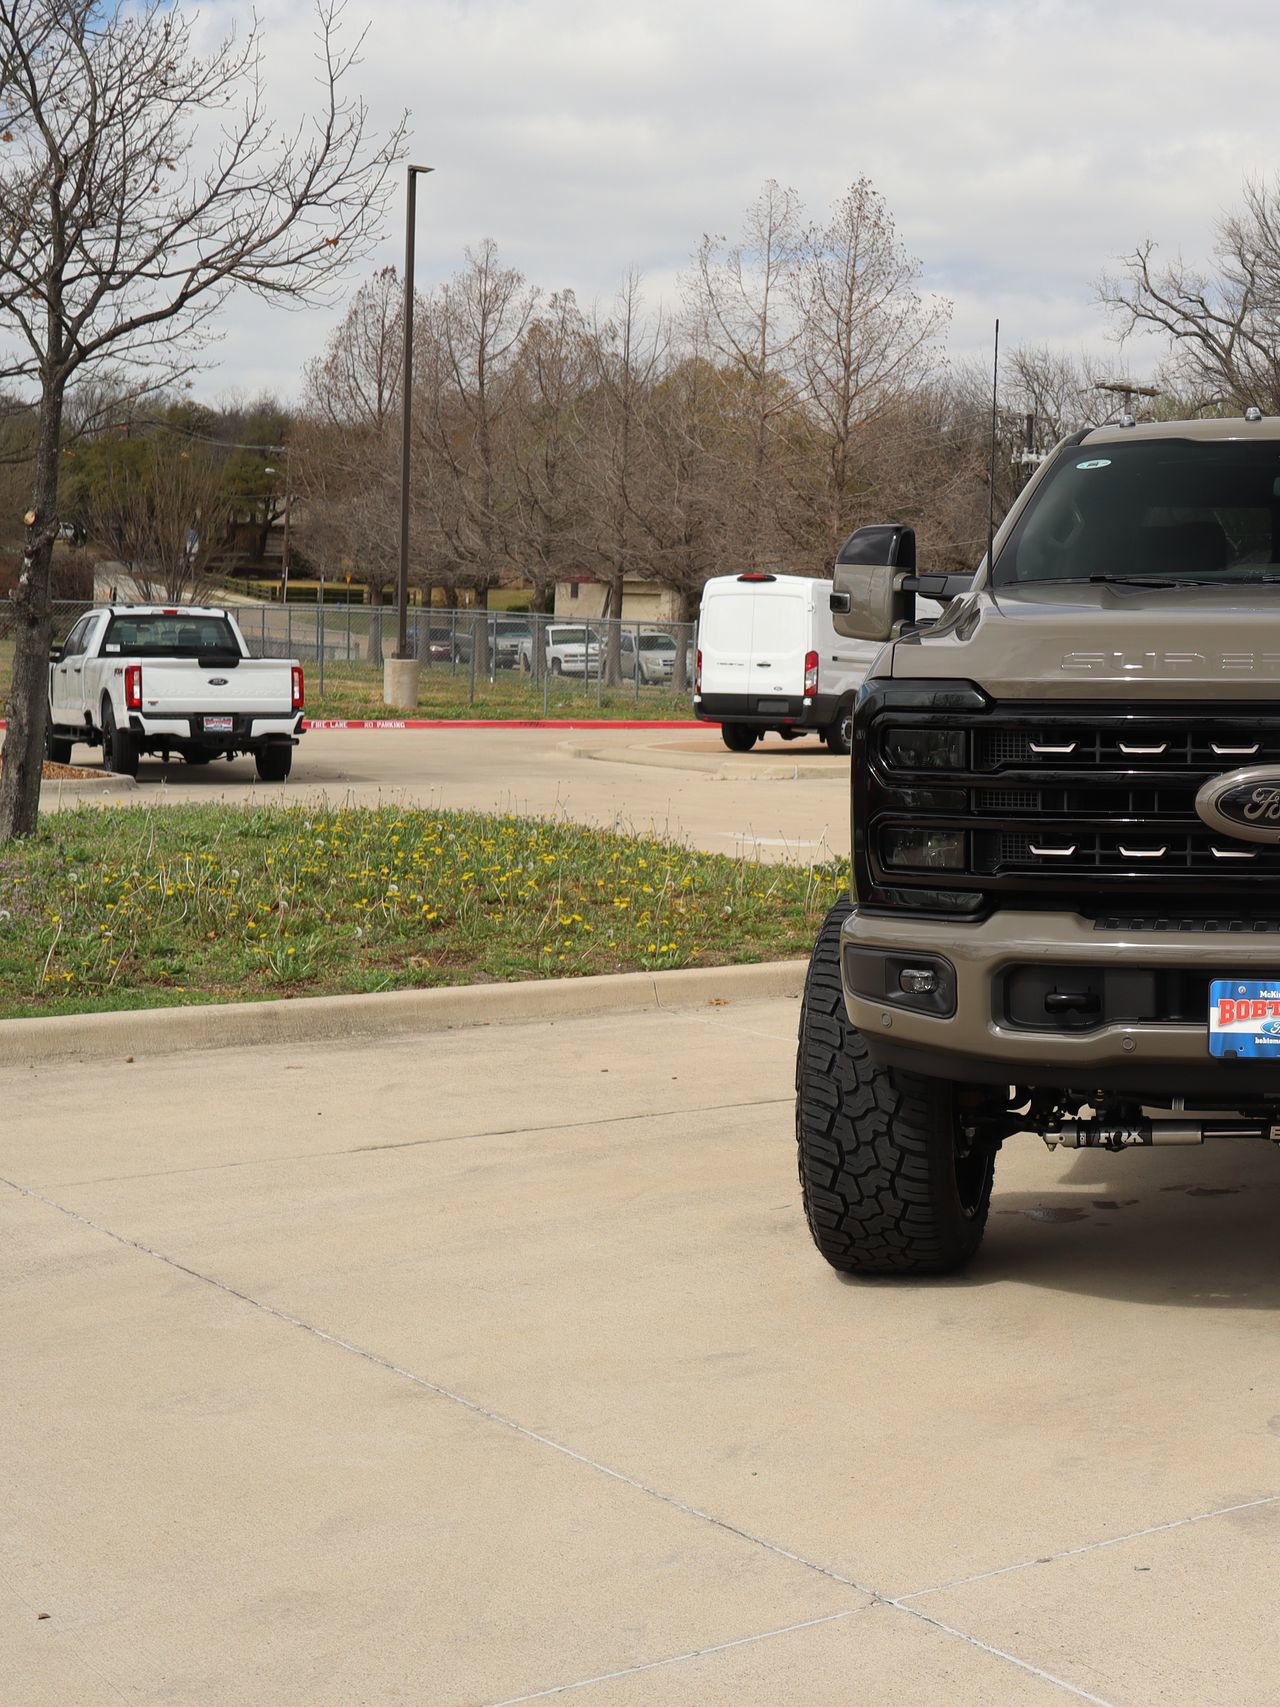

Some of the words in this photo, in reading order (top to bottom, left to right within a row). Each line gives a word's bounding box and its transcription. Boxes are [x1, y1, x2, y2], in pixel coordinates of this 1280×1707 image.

[330, 720, 348, 729] LANE
[364, 720, 374, 729] NO
[376, 720, 406, 729] PARKING
